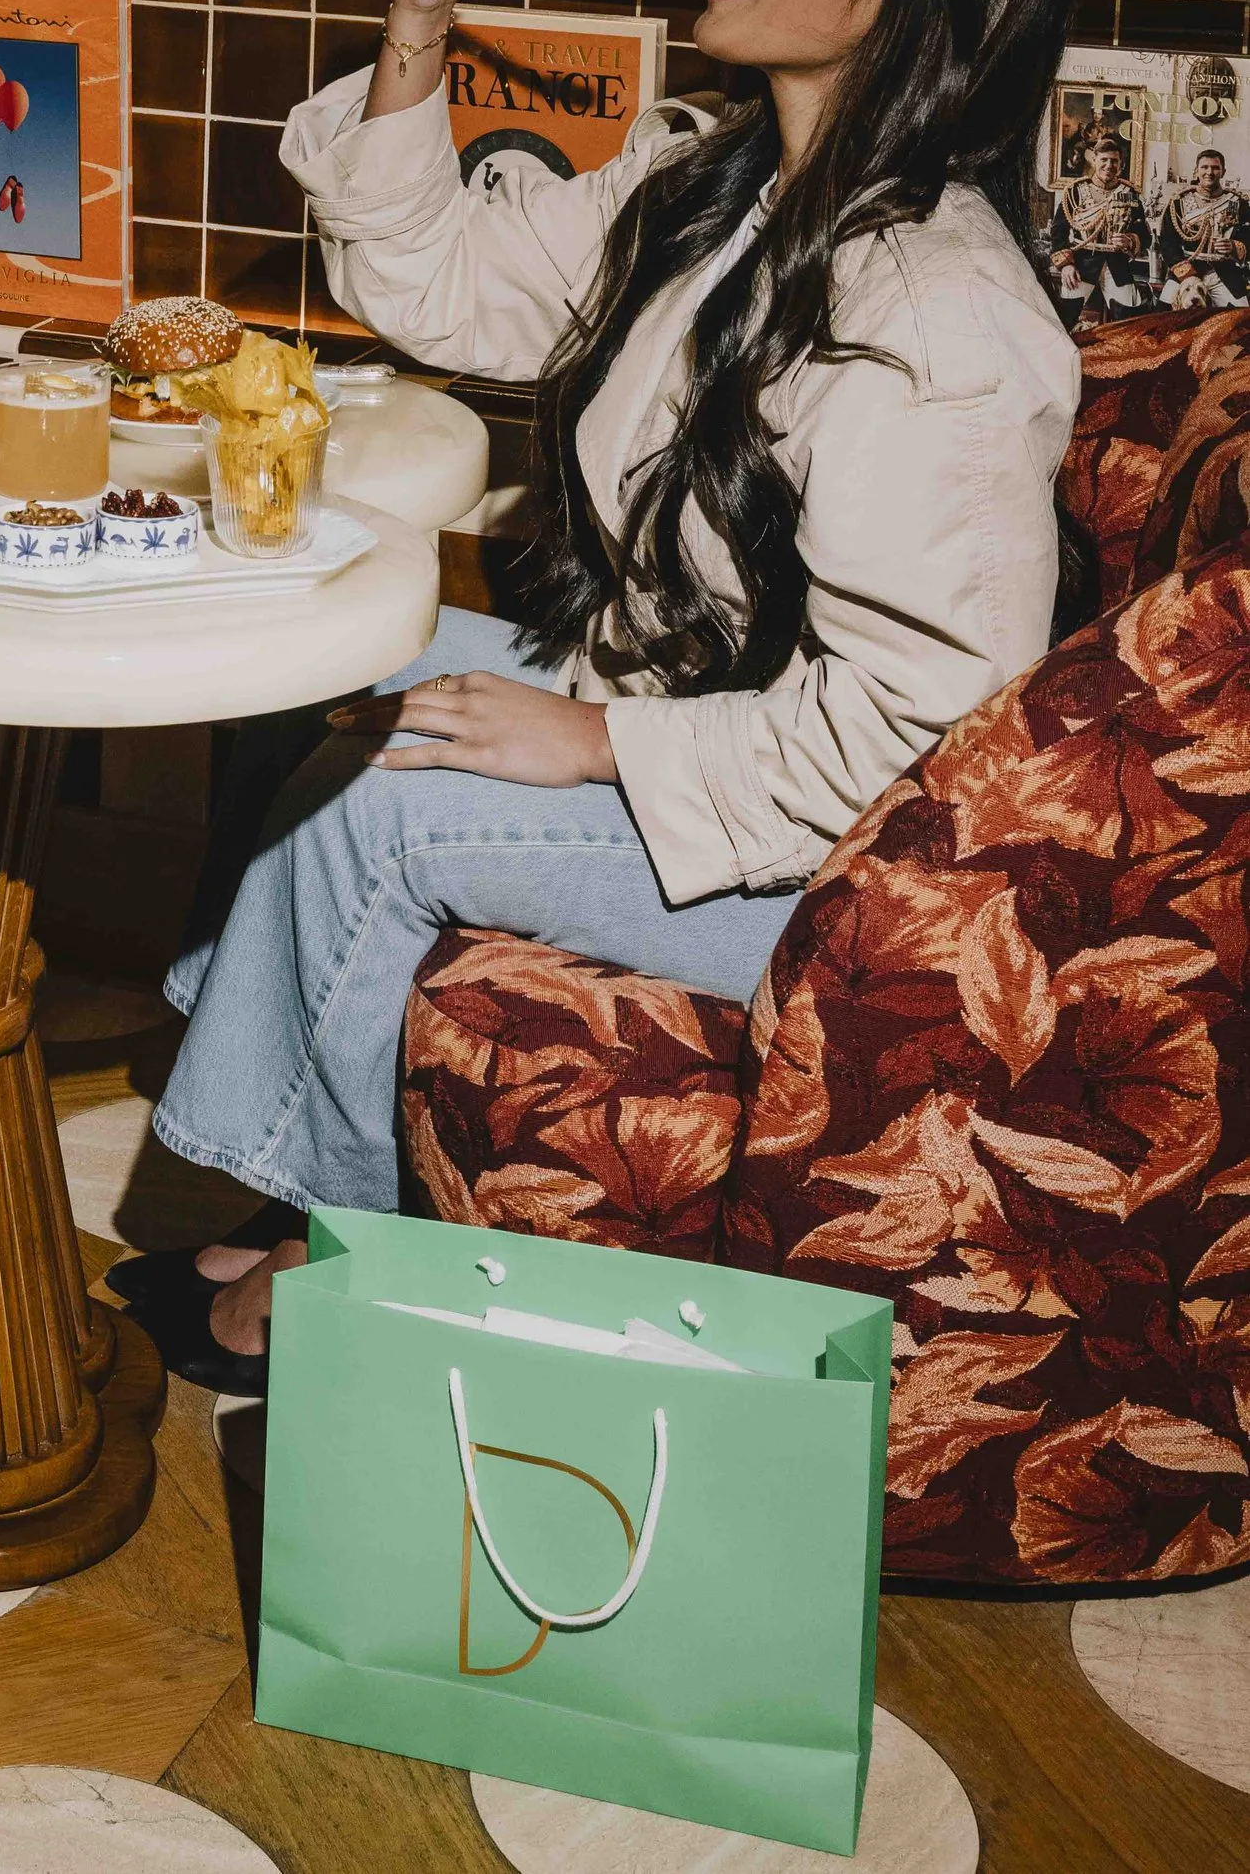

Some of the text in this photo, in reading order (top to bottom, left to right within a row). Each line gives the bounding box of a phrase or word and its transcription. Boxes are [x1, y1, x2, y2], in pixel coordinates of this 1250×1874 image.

[494, 39, 514, 62] &
[523, 41, 627, 69] TRAVEL
[1072, 64, 1119, 76] CHARLES
[1120, 68, 1152, 79] FINCH
[1191, 74, 1244, 86] ANTHONY
[443, 61, 627, 121] RANCE
[1091, 89, 1243, 119] LONDON
[1118, 119, 1213, 147] CHIC
